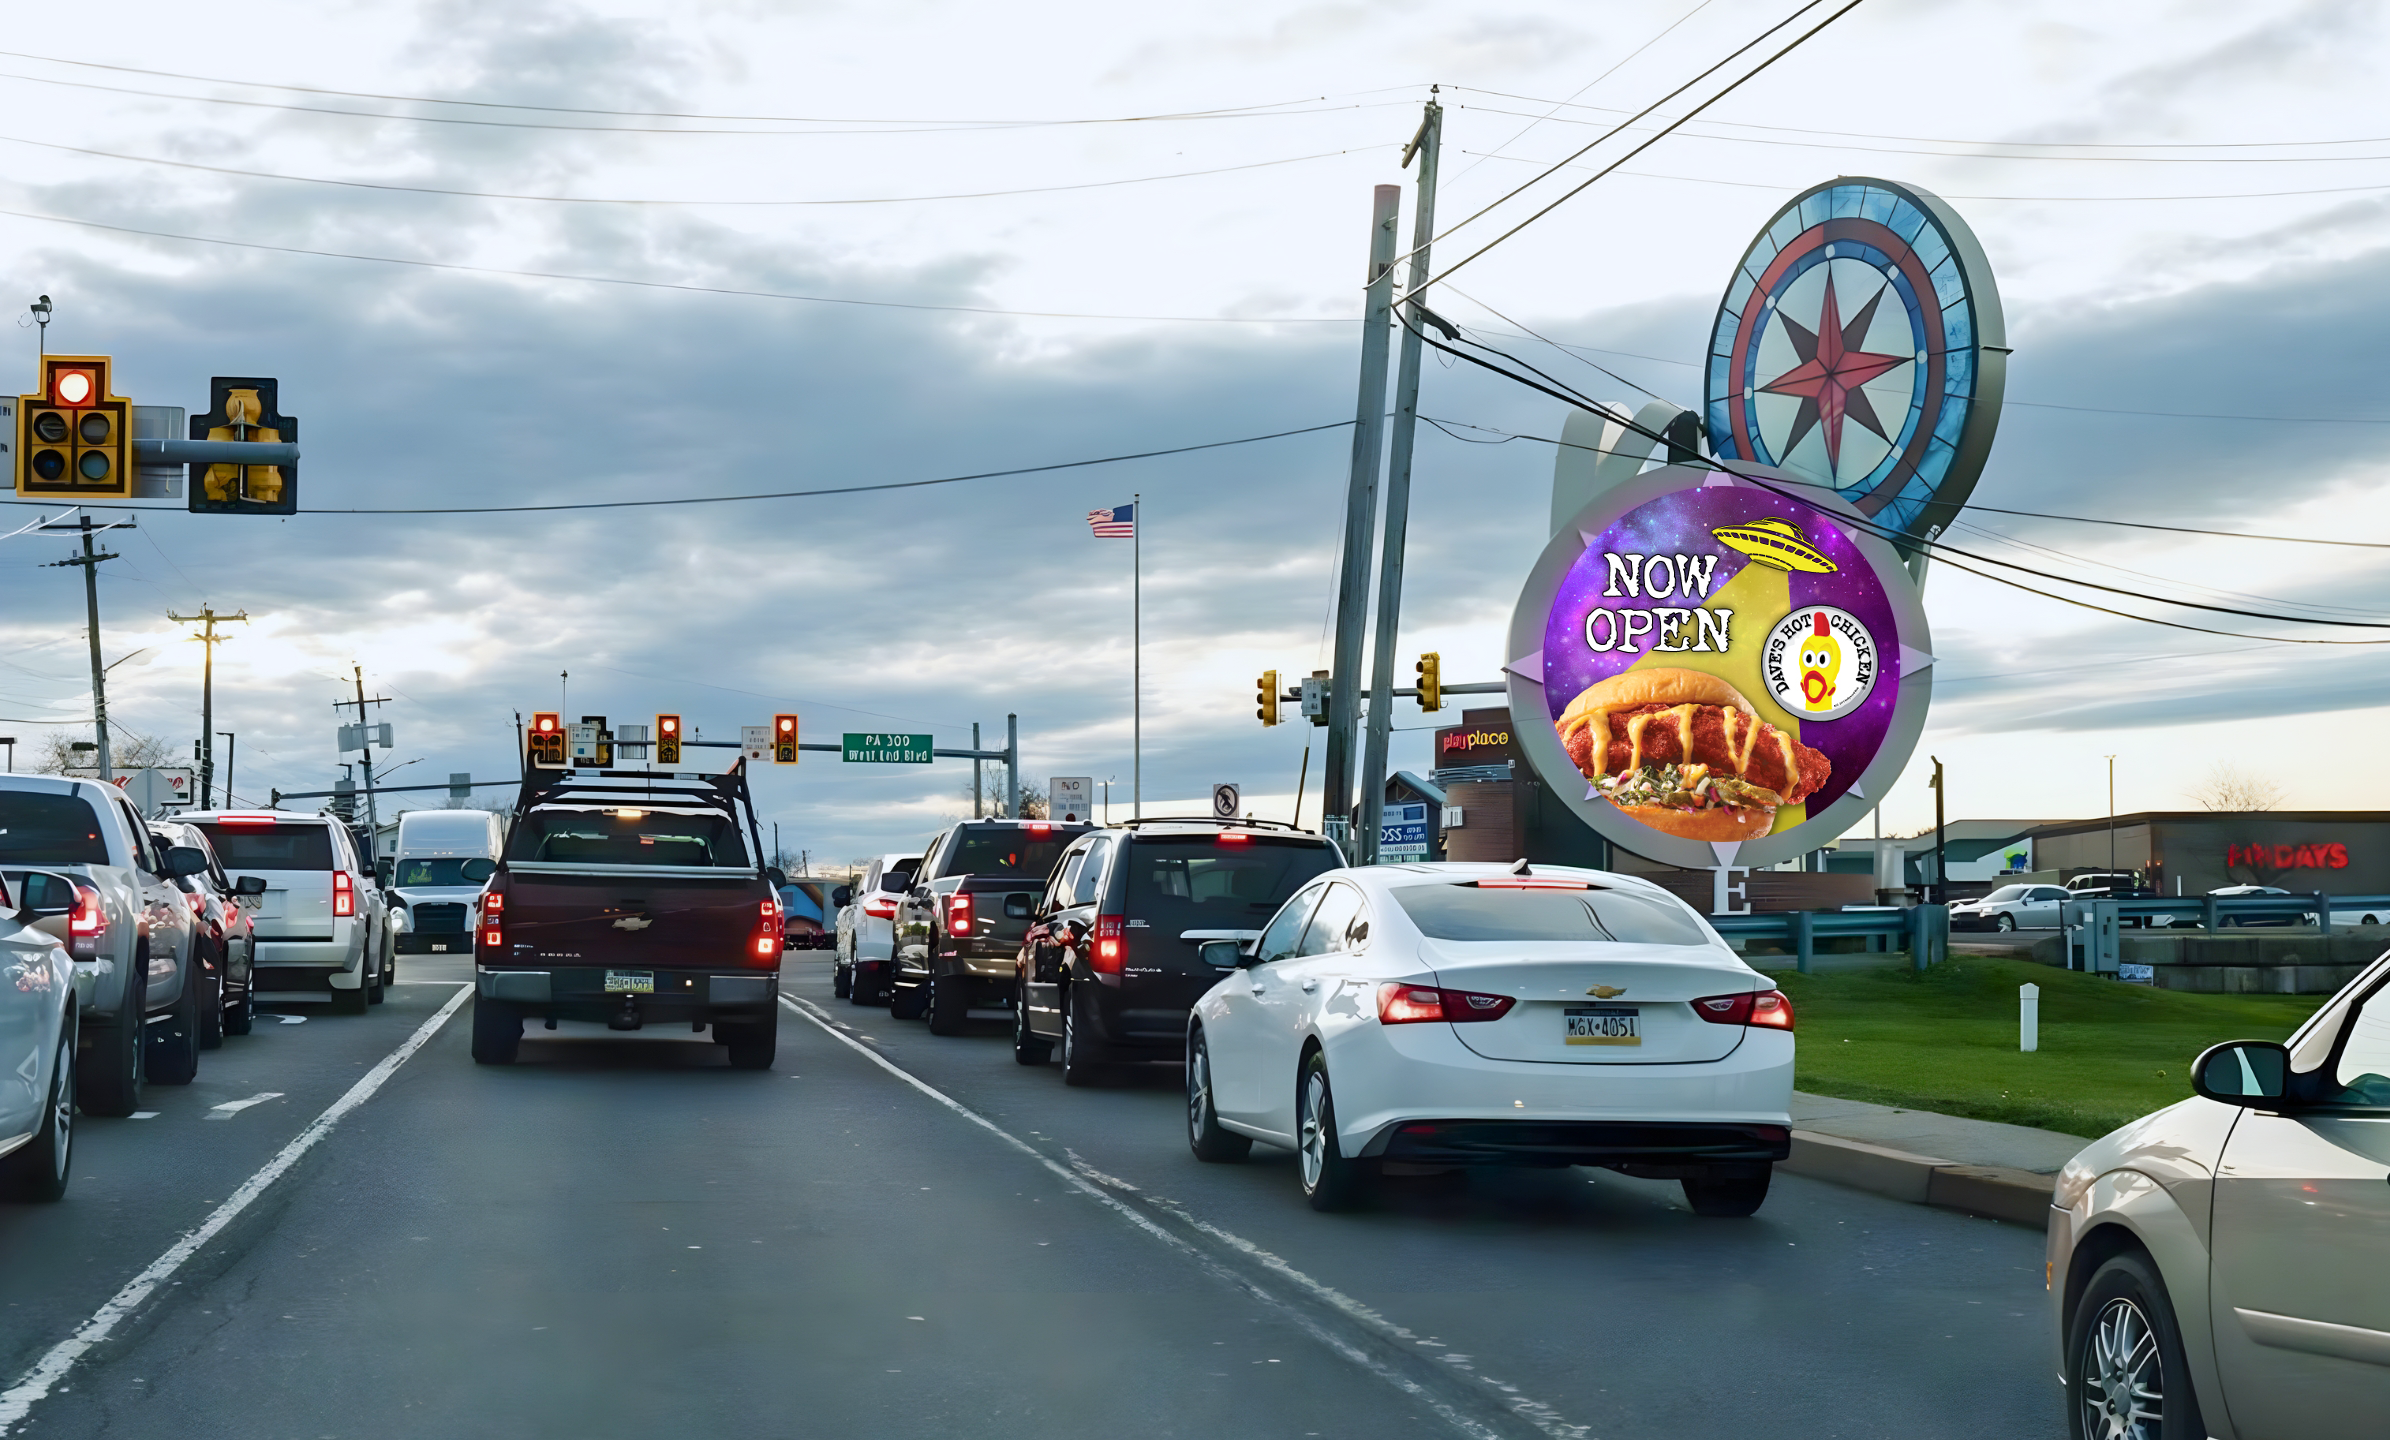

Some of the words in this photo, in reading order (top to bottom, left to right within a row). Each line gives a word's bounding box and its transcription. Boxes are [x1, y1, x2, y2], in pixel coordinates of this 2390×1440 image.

[1602, 552, 1720, 599] NOW
[1585, 607, 1735, 653] OPEN
[1768, 638, 1790, 695] DAVE'S
[1780, 613, 1812, 640] HOT
[1830, 614, 1872, 686] CHICKEN
